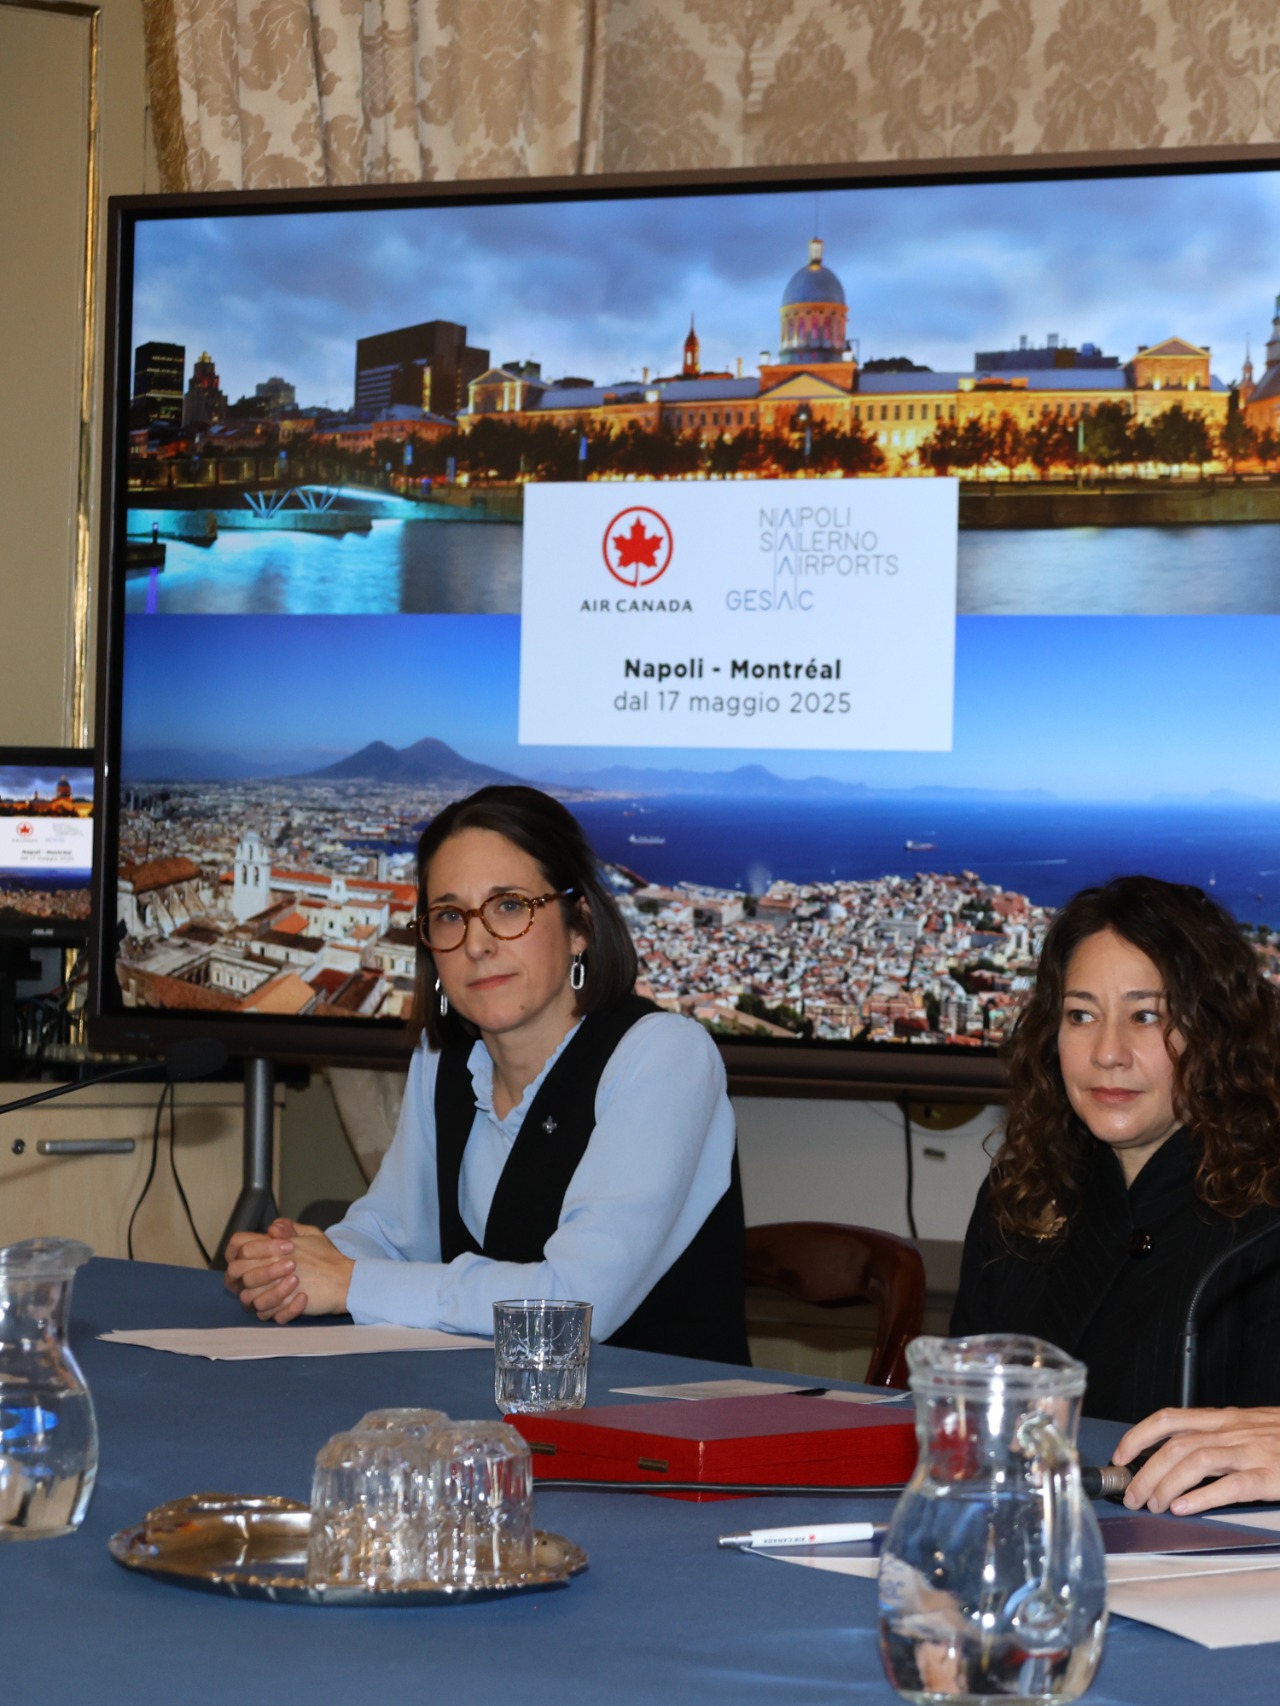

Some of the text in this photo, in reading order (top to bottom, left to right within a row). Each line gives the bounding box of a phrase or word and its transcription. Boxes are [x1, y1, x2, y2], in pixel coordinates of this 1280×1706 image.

[759, 506, 851, 528] NAPOLI
[759, 530, 878, 552] SALERNO
[778, 555, 899, 576] AIRPORTS
[580, 599, 693, 613] AIR CANADA
[725, 589, 814, 611] GESAC
[624, 657, 704, 683] Napoli
[731, 658, 841, 680] Montréal
[613, 690, 852, 717] dal 17 maggio 2025
